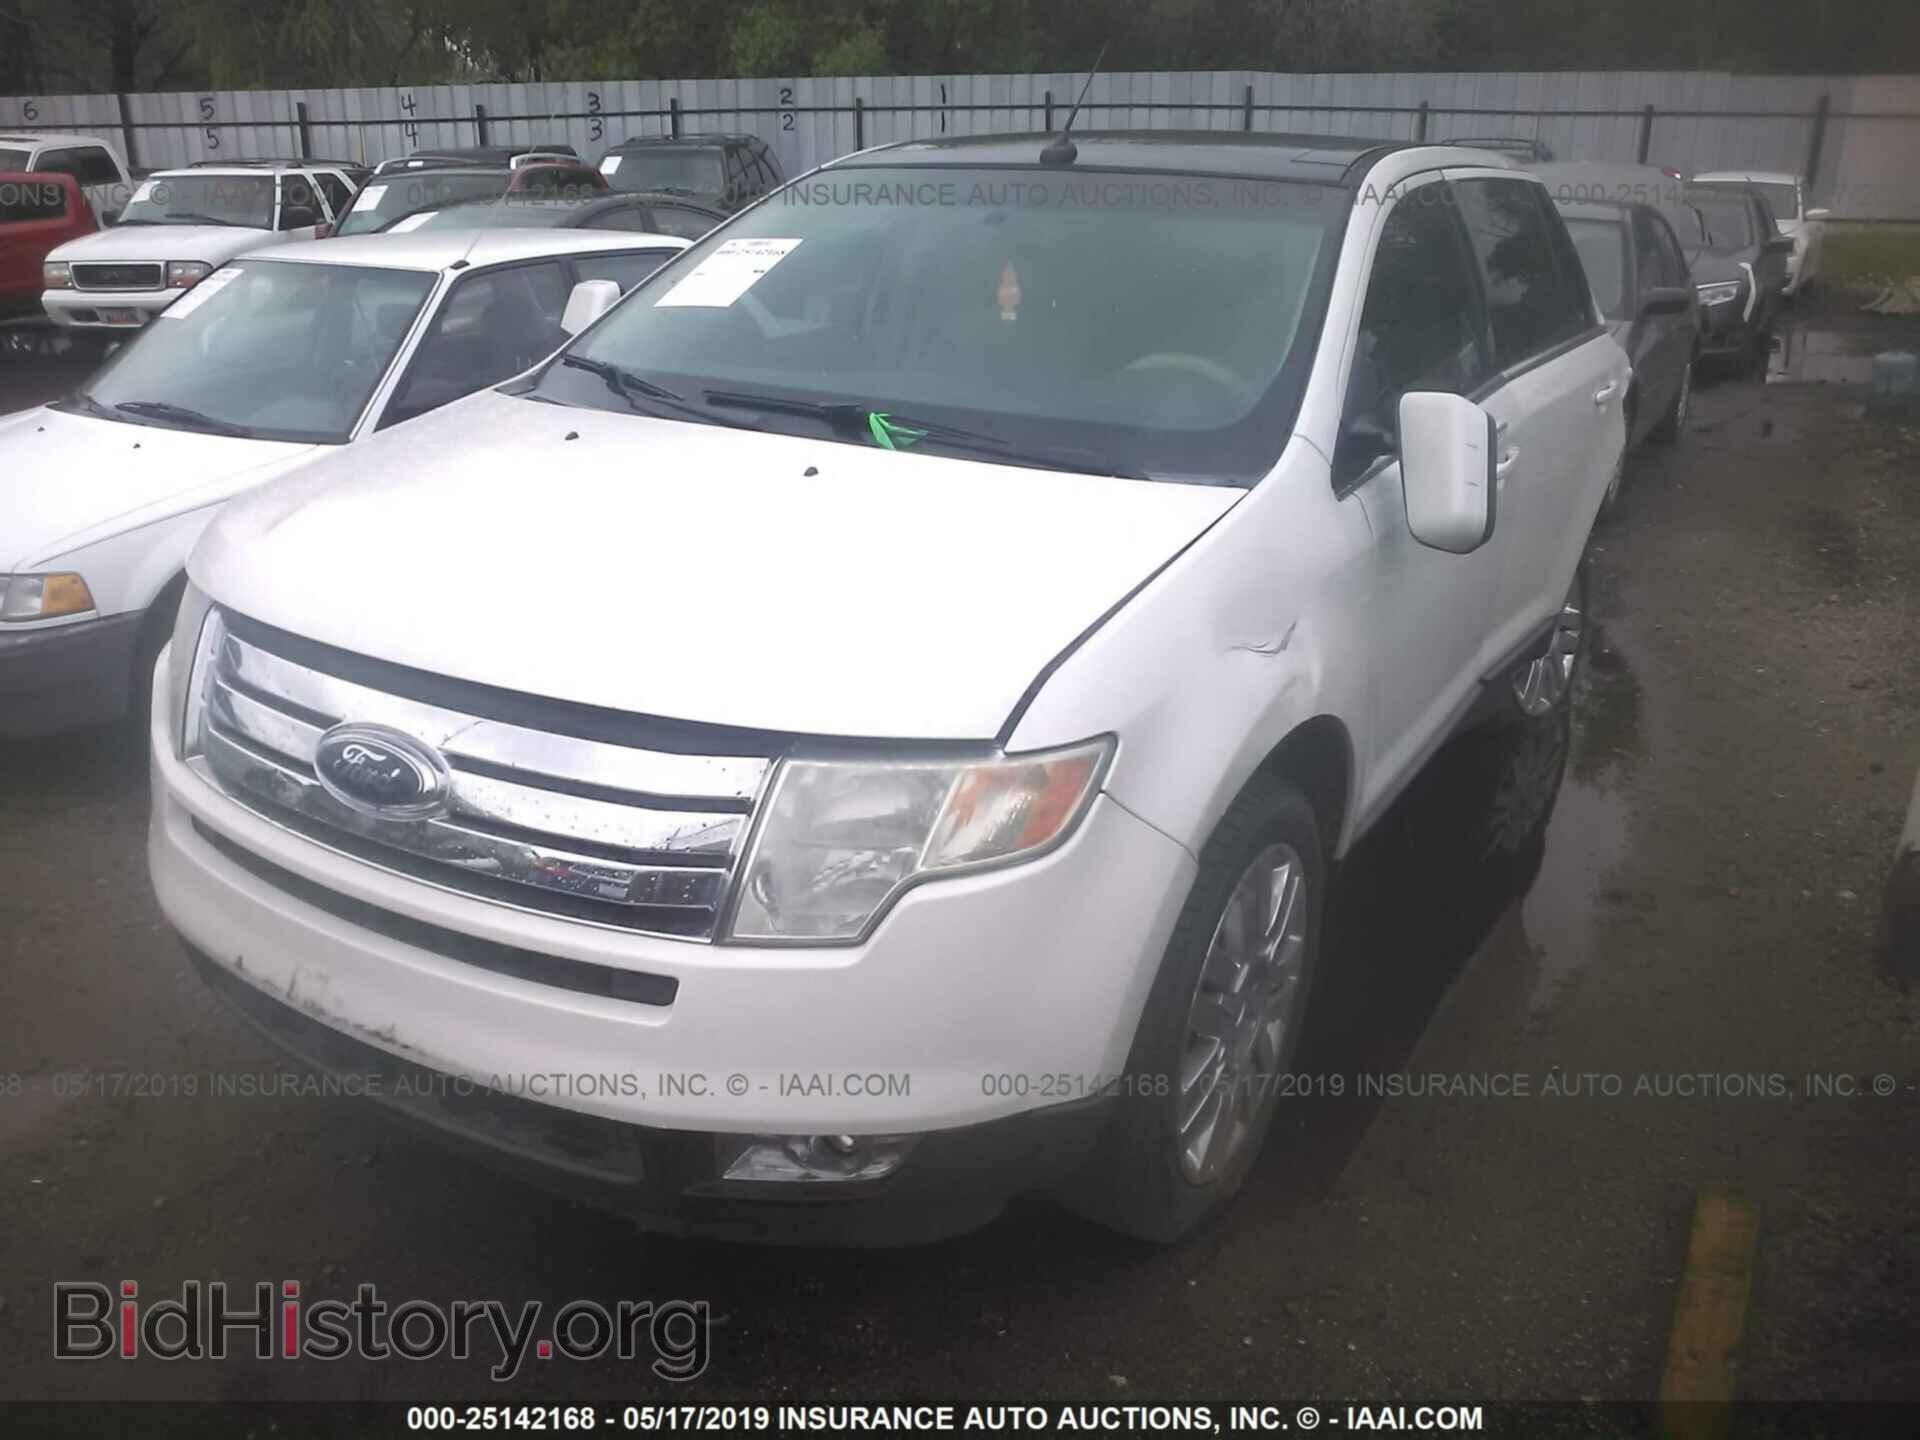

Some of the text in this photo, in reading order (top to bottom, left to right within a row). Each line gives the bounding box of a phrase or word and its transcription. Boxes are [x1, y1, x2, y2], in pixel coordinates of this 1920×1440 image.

[402, 95, 417, 117] 4
[588, 92, 601, 115] 3
[779, 87, 794, 105] 2
[24, 101, 39, 120] 6
[199, 98, 215, 120] 5
[590, 119, 603, 142] 3
[782, 113, 796, 132] 2
[206, 127, 220, 149] 5
[405, 122, 418, 147] 4
